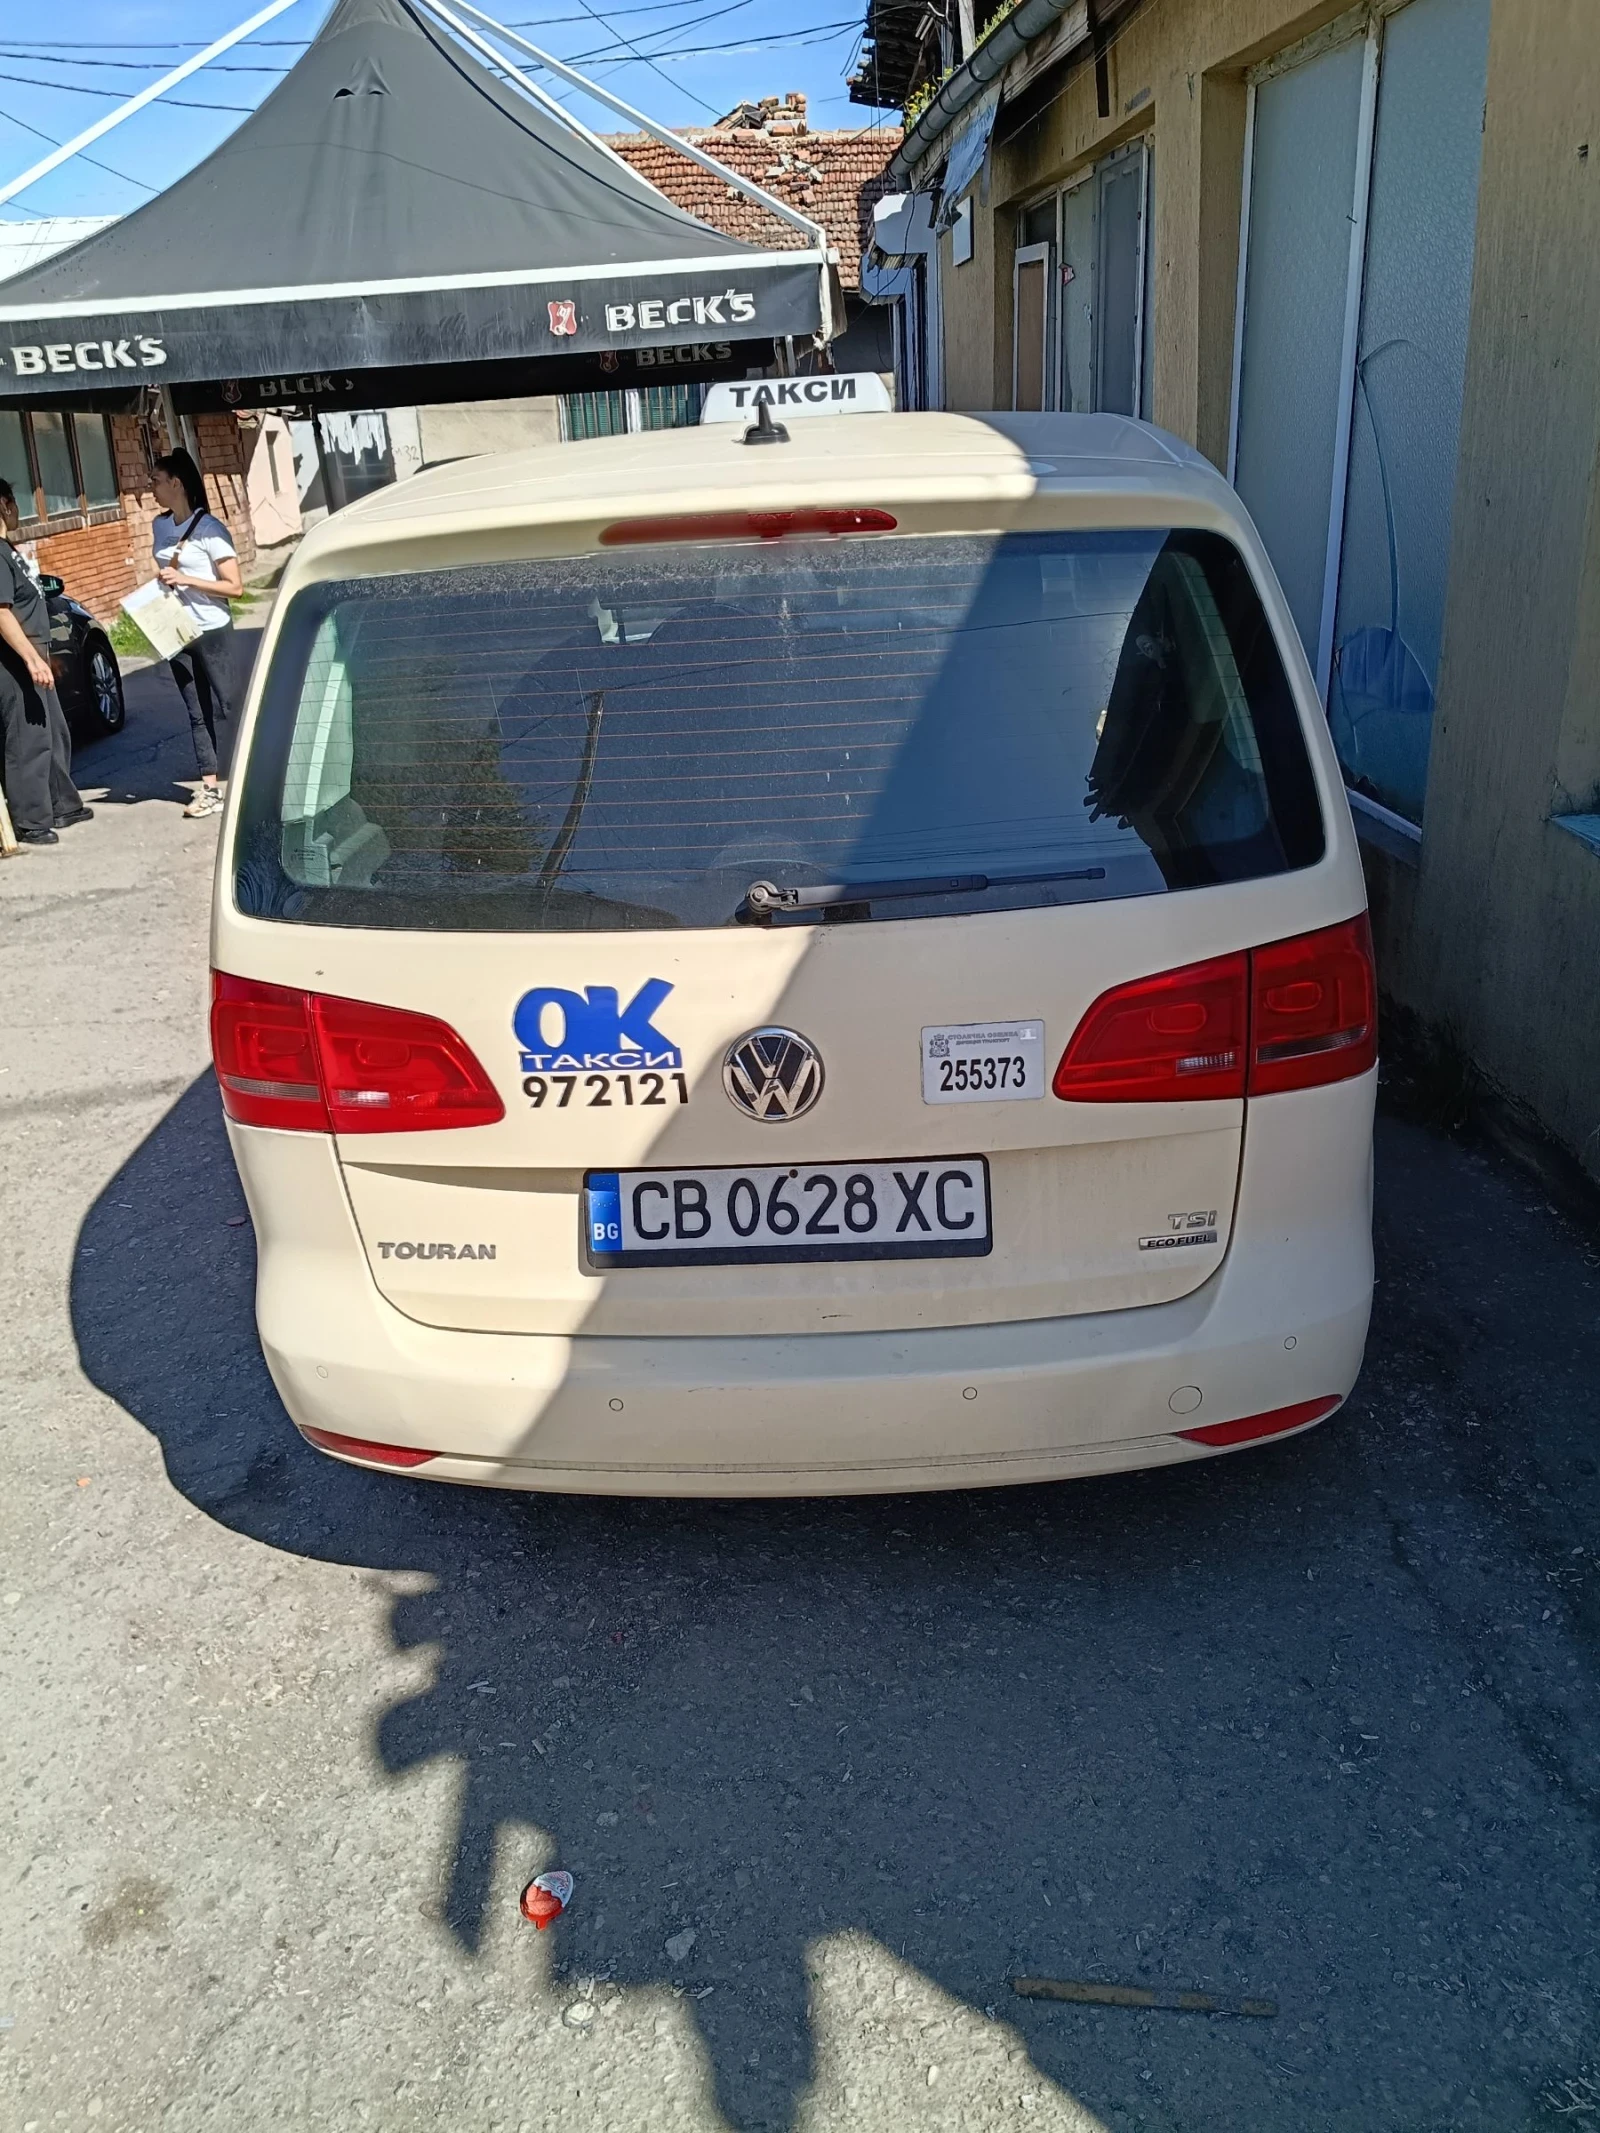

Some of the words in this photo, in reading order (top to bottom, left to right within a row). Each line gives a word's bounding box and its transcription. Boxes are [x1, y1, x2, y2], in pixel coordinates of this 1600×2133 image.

[605, 288, 755, 332] BECK'S
[10, 334, 167, 376] BECK'S
[729, 378, 857, 408] ТАКСИ
[525, 1052, 676, 1069] ТАКСИ
[940, 1056, 1026, 1092] 255373
[522, 1073, 689, 1108] 972121
[726, 1174, 880, 1237] 0628
[1167, 1210, 1218, 1230] TSI
[593, 1222, 619, 1240] BG
[1147, 1234, 1211, 1248] ECOFUEL
[377, 1241, 497, 1260] TOURAN
